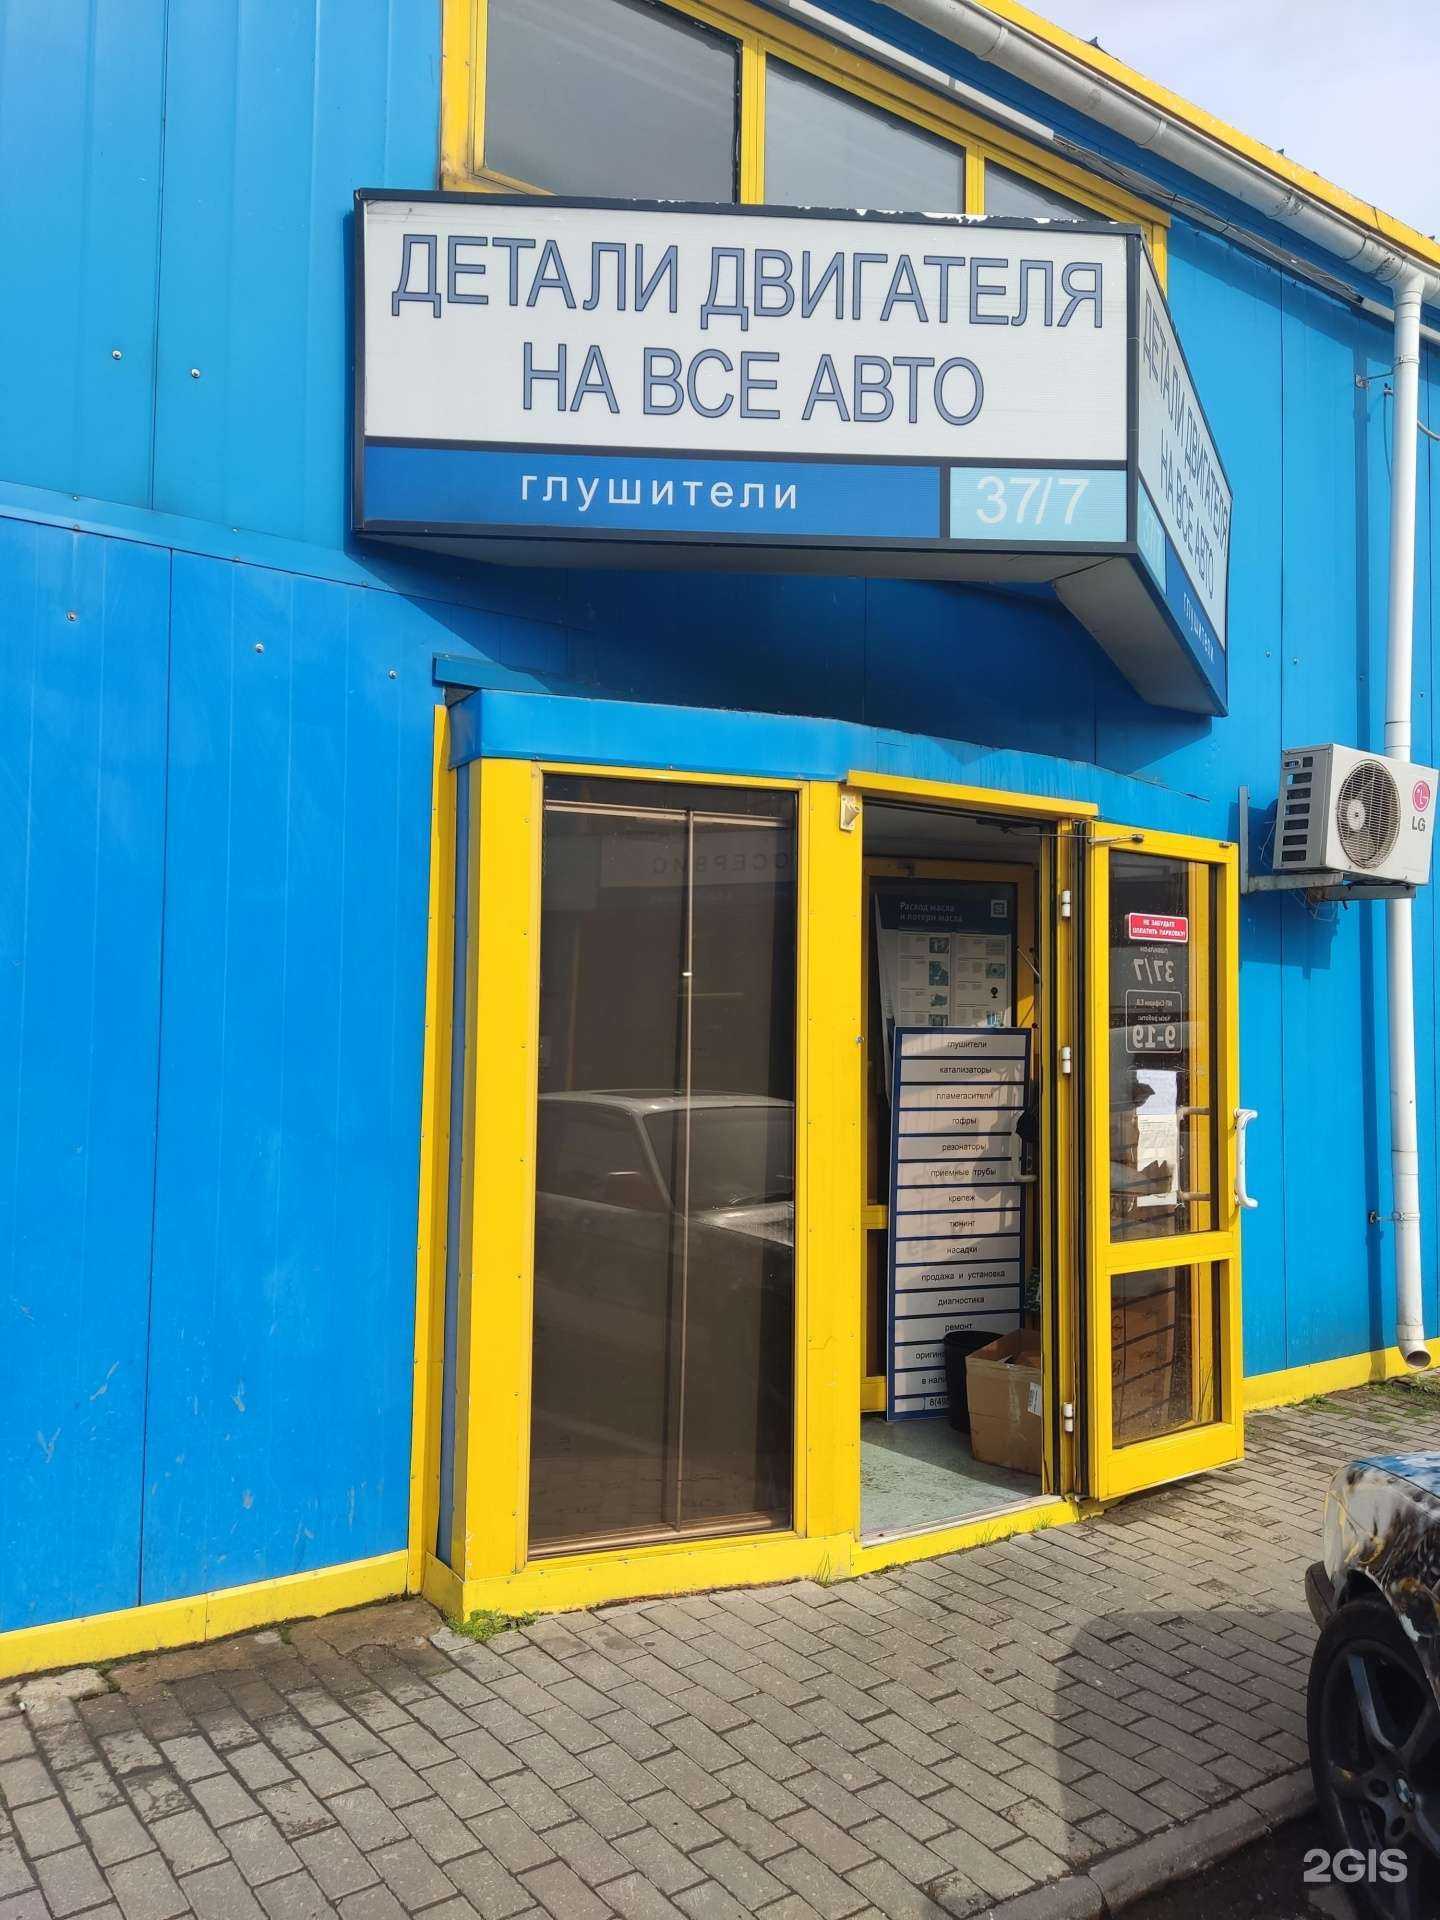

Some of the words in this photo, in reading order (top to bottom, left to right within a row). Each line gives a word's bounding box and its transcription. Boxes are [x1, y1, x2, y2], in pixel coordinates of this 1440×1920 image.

[391, 234, 678, 319] ДЕТАЛИ
[700, 246, 1104, 331] ДВИГАТЕЛЯ
[523, 341, 620, 415] НА
[643, 347, 781, 420] ВСЕ
[801, 353, 985, 426] АВТО
[1143, 288, 1185, 447] ДЕТАЛИ
[1185, 407, 1229, 557] ДВИГАТЕЛЯ
[521, 473, 797, 512] глушители
[975, 475, 1090, 526] 37/7
[1161, 428, 1175, 516] НА
[1177, 467, 1194, 554] ВСЕ
[1195, 517, 1215, 600] АВТО
[1411, 815, 1426, 832] LG
[947, 1041, 987, 1050] глушители
[939, 1066, 992, 1075] катализаторы
[936, 1092, 993, 1100] пламегасители
[952, 1117, 977, 1126] гофры
[941, 1143, 987, 1152] резонаторы
[973, 1168, 997, 1177] трубы
[948, 1195, 975, 1203] крепеж
[949, 1219, 975, 1228] тюнинг
[946, 1246, 978, 1255] насадки
[921, 1272, 955, 1282] продажа
[967, 1270, 1006, 1281] установка
[938, 1296, 985, 1306] диагностика
[944, 1323, 973, 1333] ремонт
